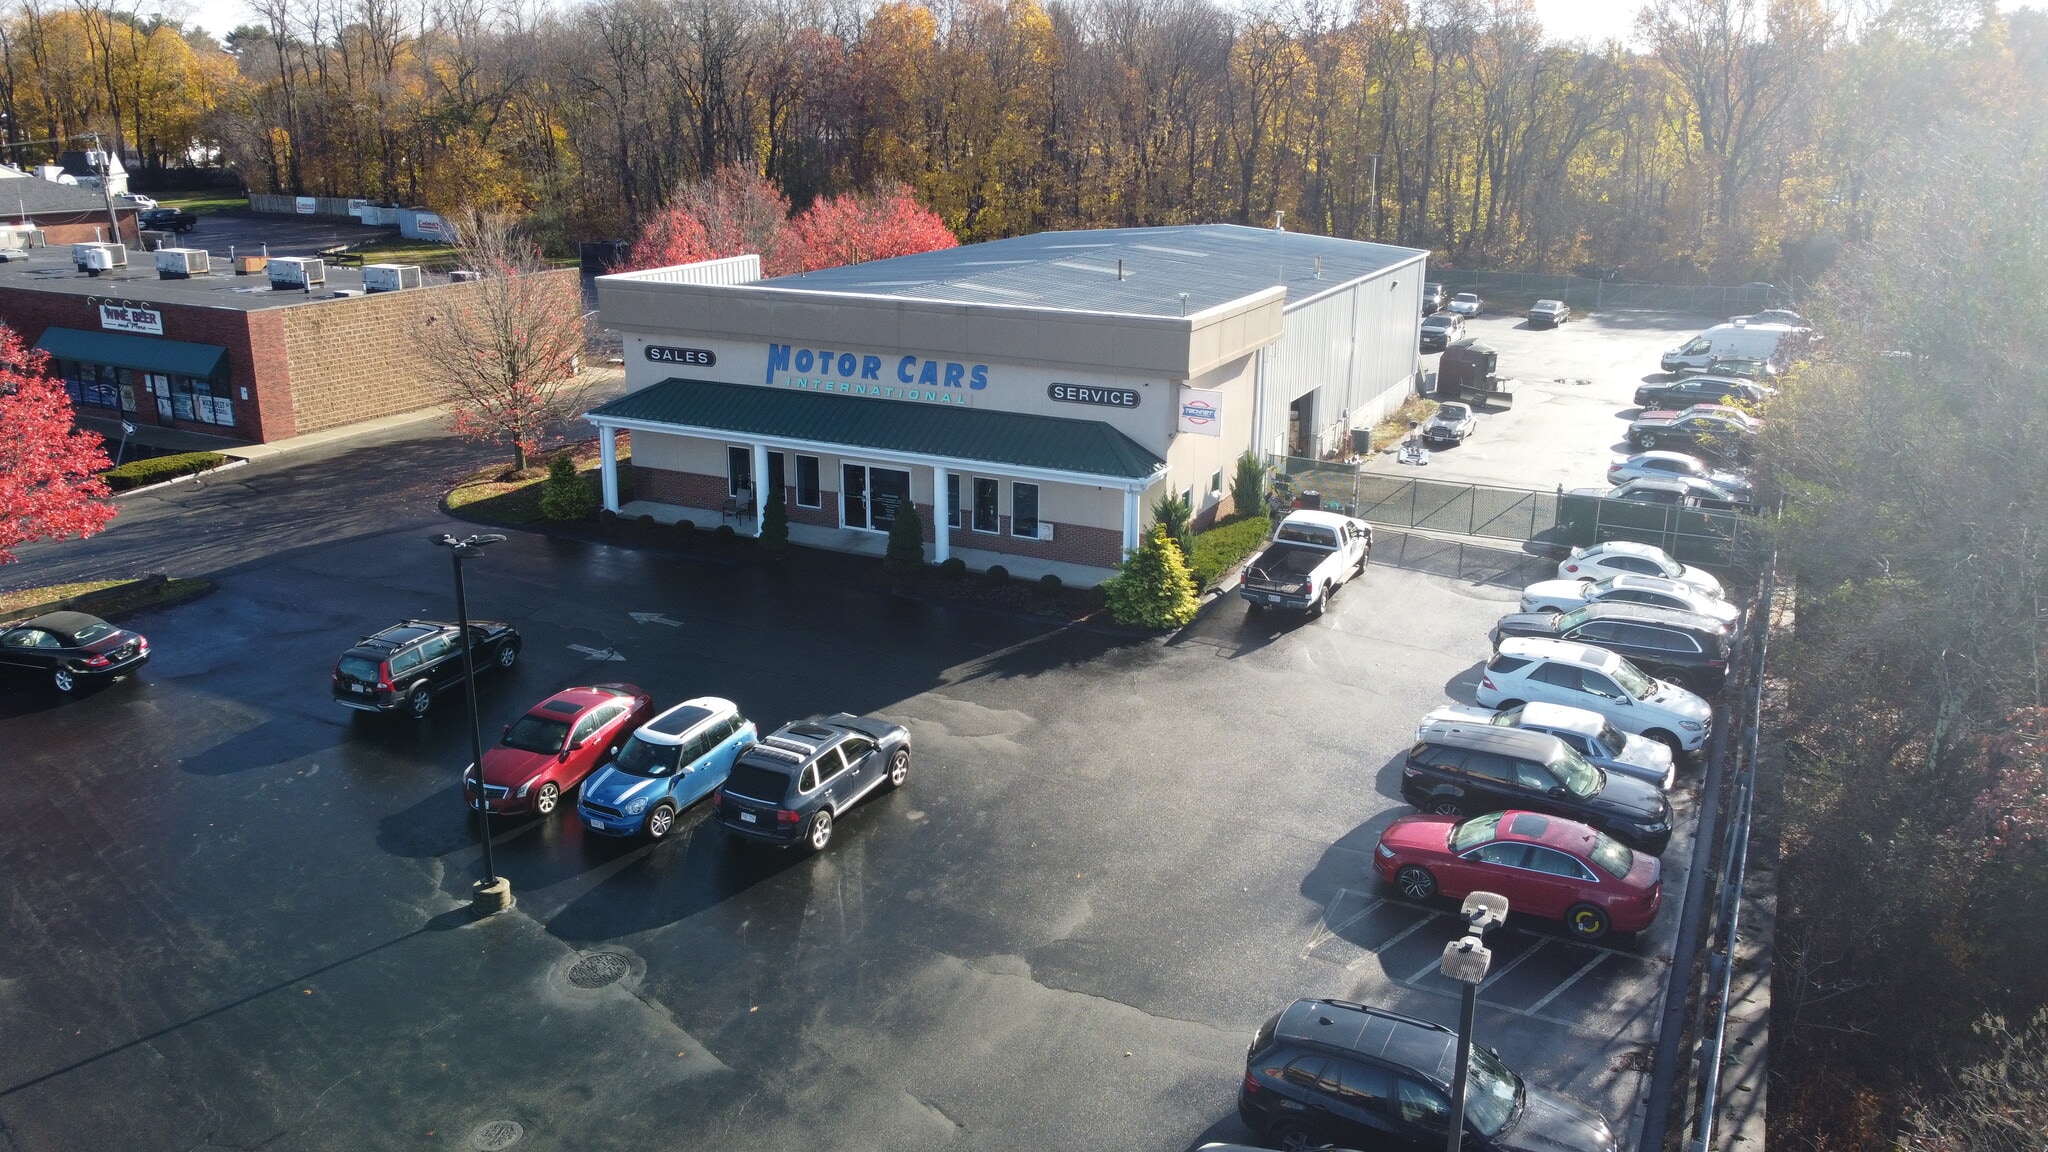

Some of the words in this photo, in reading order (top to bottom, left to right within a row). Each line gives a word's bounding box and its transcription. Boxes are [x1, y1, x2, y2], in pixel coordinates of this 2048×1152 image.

[132, 311, 157, 325] BEER
[651, 348, 708, 364] SALES
[766, 343, 881, 385] MOTOR
[897, 355, 988, 391] CARS
[786, 377, 967, 405] INTERNATIONAL
[1054, 387, 1134, 405] SERVICE
